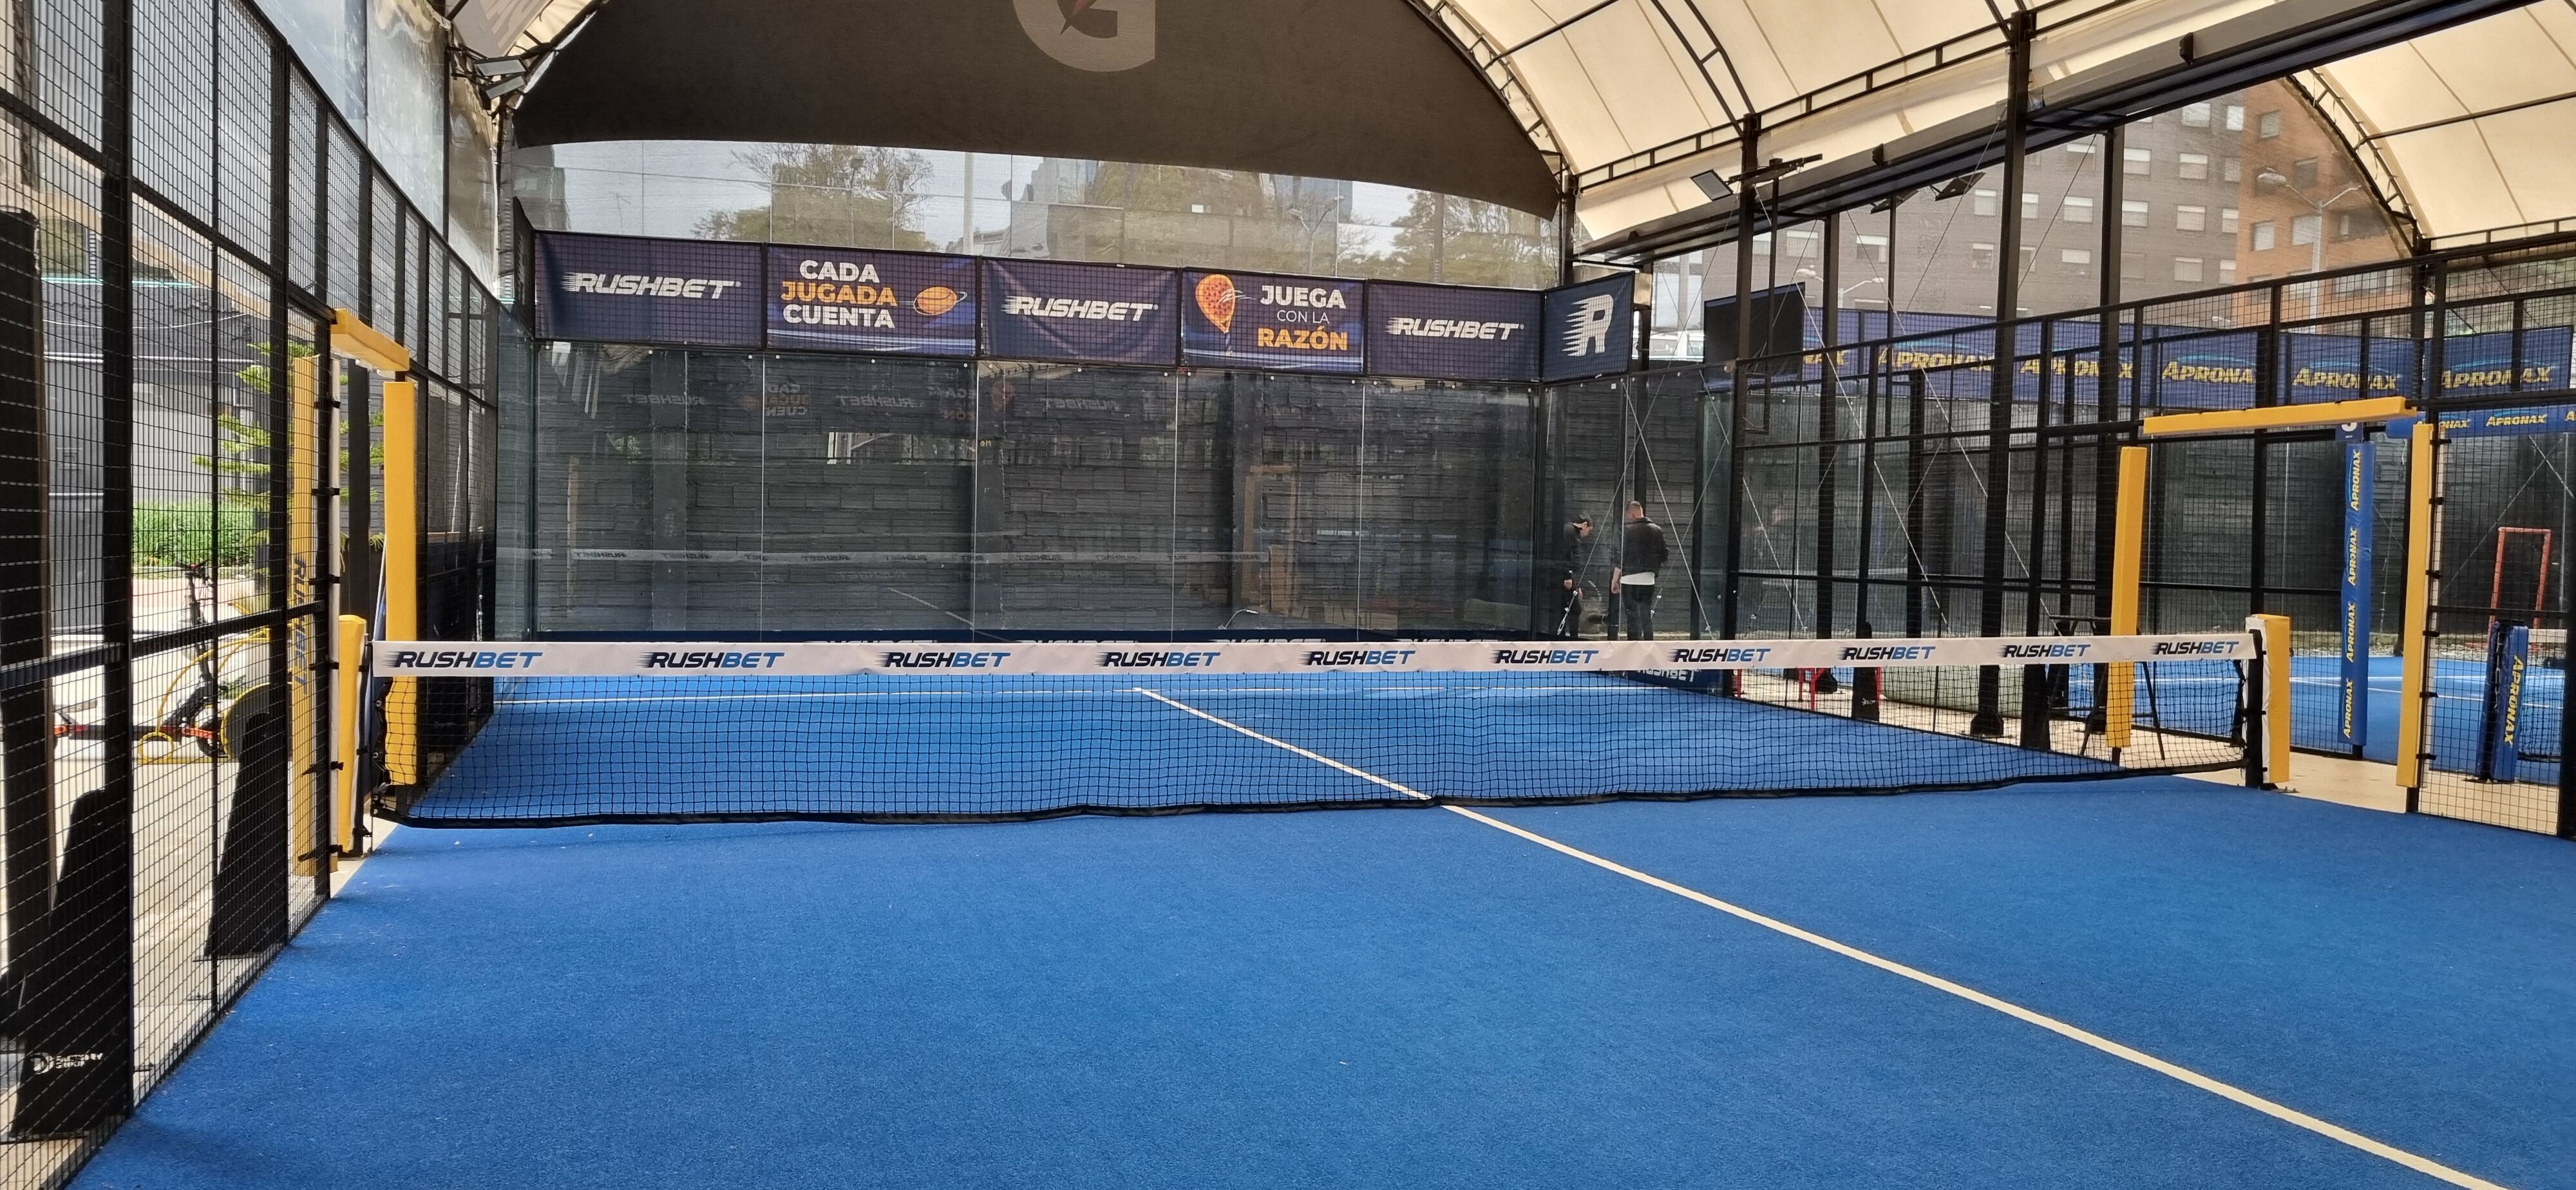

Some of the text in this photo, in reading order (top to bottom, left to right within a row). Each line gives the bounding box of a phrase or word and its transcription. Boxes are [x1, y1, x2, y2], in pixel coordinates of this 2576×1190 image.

[800, 260, 880, 283] CADA
[561, 272, 735, 299] RUSHBET
[781, 281, 898, 307] JUGADA
[1260, 285, 1347, 309] JUEGA
[782, 304, 895, 328] CUENTA
[1001, 296, 1153, 322] RUSHBET
[1276, 309, 1330, 325] CON LA
[1258, 325, 1347, 351] RAZÓN
[1385, 317, 1519, 340] RUSHBET
[2161, 361, 2256, 384] APRONA
[2485, 415, 2547, 427] APRONAX
[2349, 449, 2361, 512] APRONAX
[2347, 528, 2358, 587] APRONAX
[2345, 602, 2356, 663] APRONAX
[383, 652, 544, 668] RUSHBET
[636, 652, 785, 668] RUSHBET
[873, 652, 1011, 667] RUSHBET
[1097, 652, 1221, 666] RUSHBET
[1300, 650, 1416, 665] RUSHBET
[1490, 650, 1599, 664] RUSHBET
[1668, 649, 1772, 662] RUSHBET
[1837, 647, 1936, 660] RUSHBET
[1998, 645, 2090, 657] RUSHBET
[2151, 642, 2239, 655] RUSHBET
[2342, 677, 2353, 739] APRONAX
